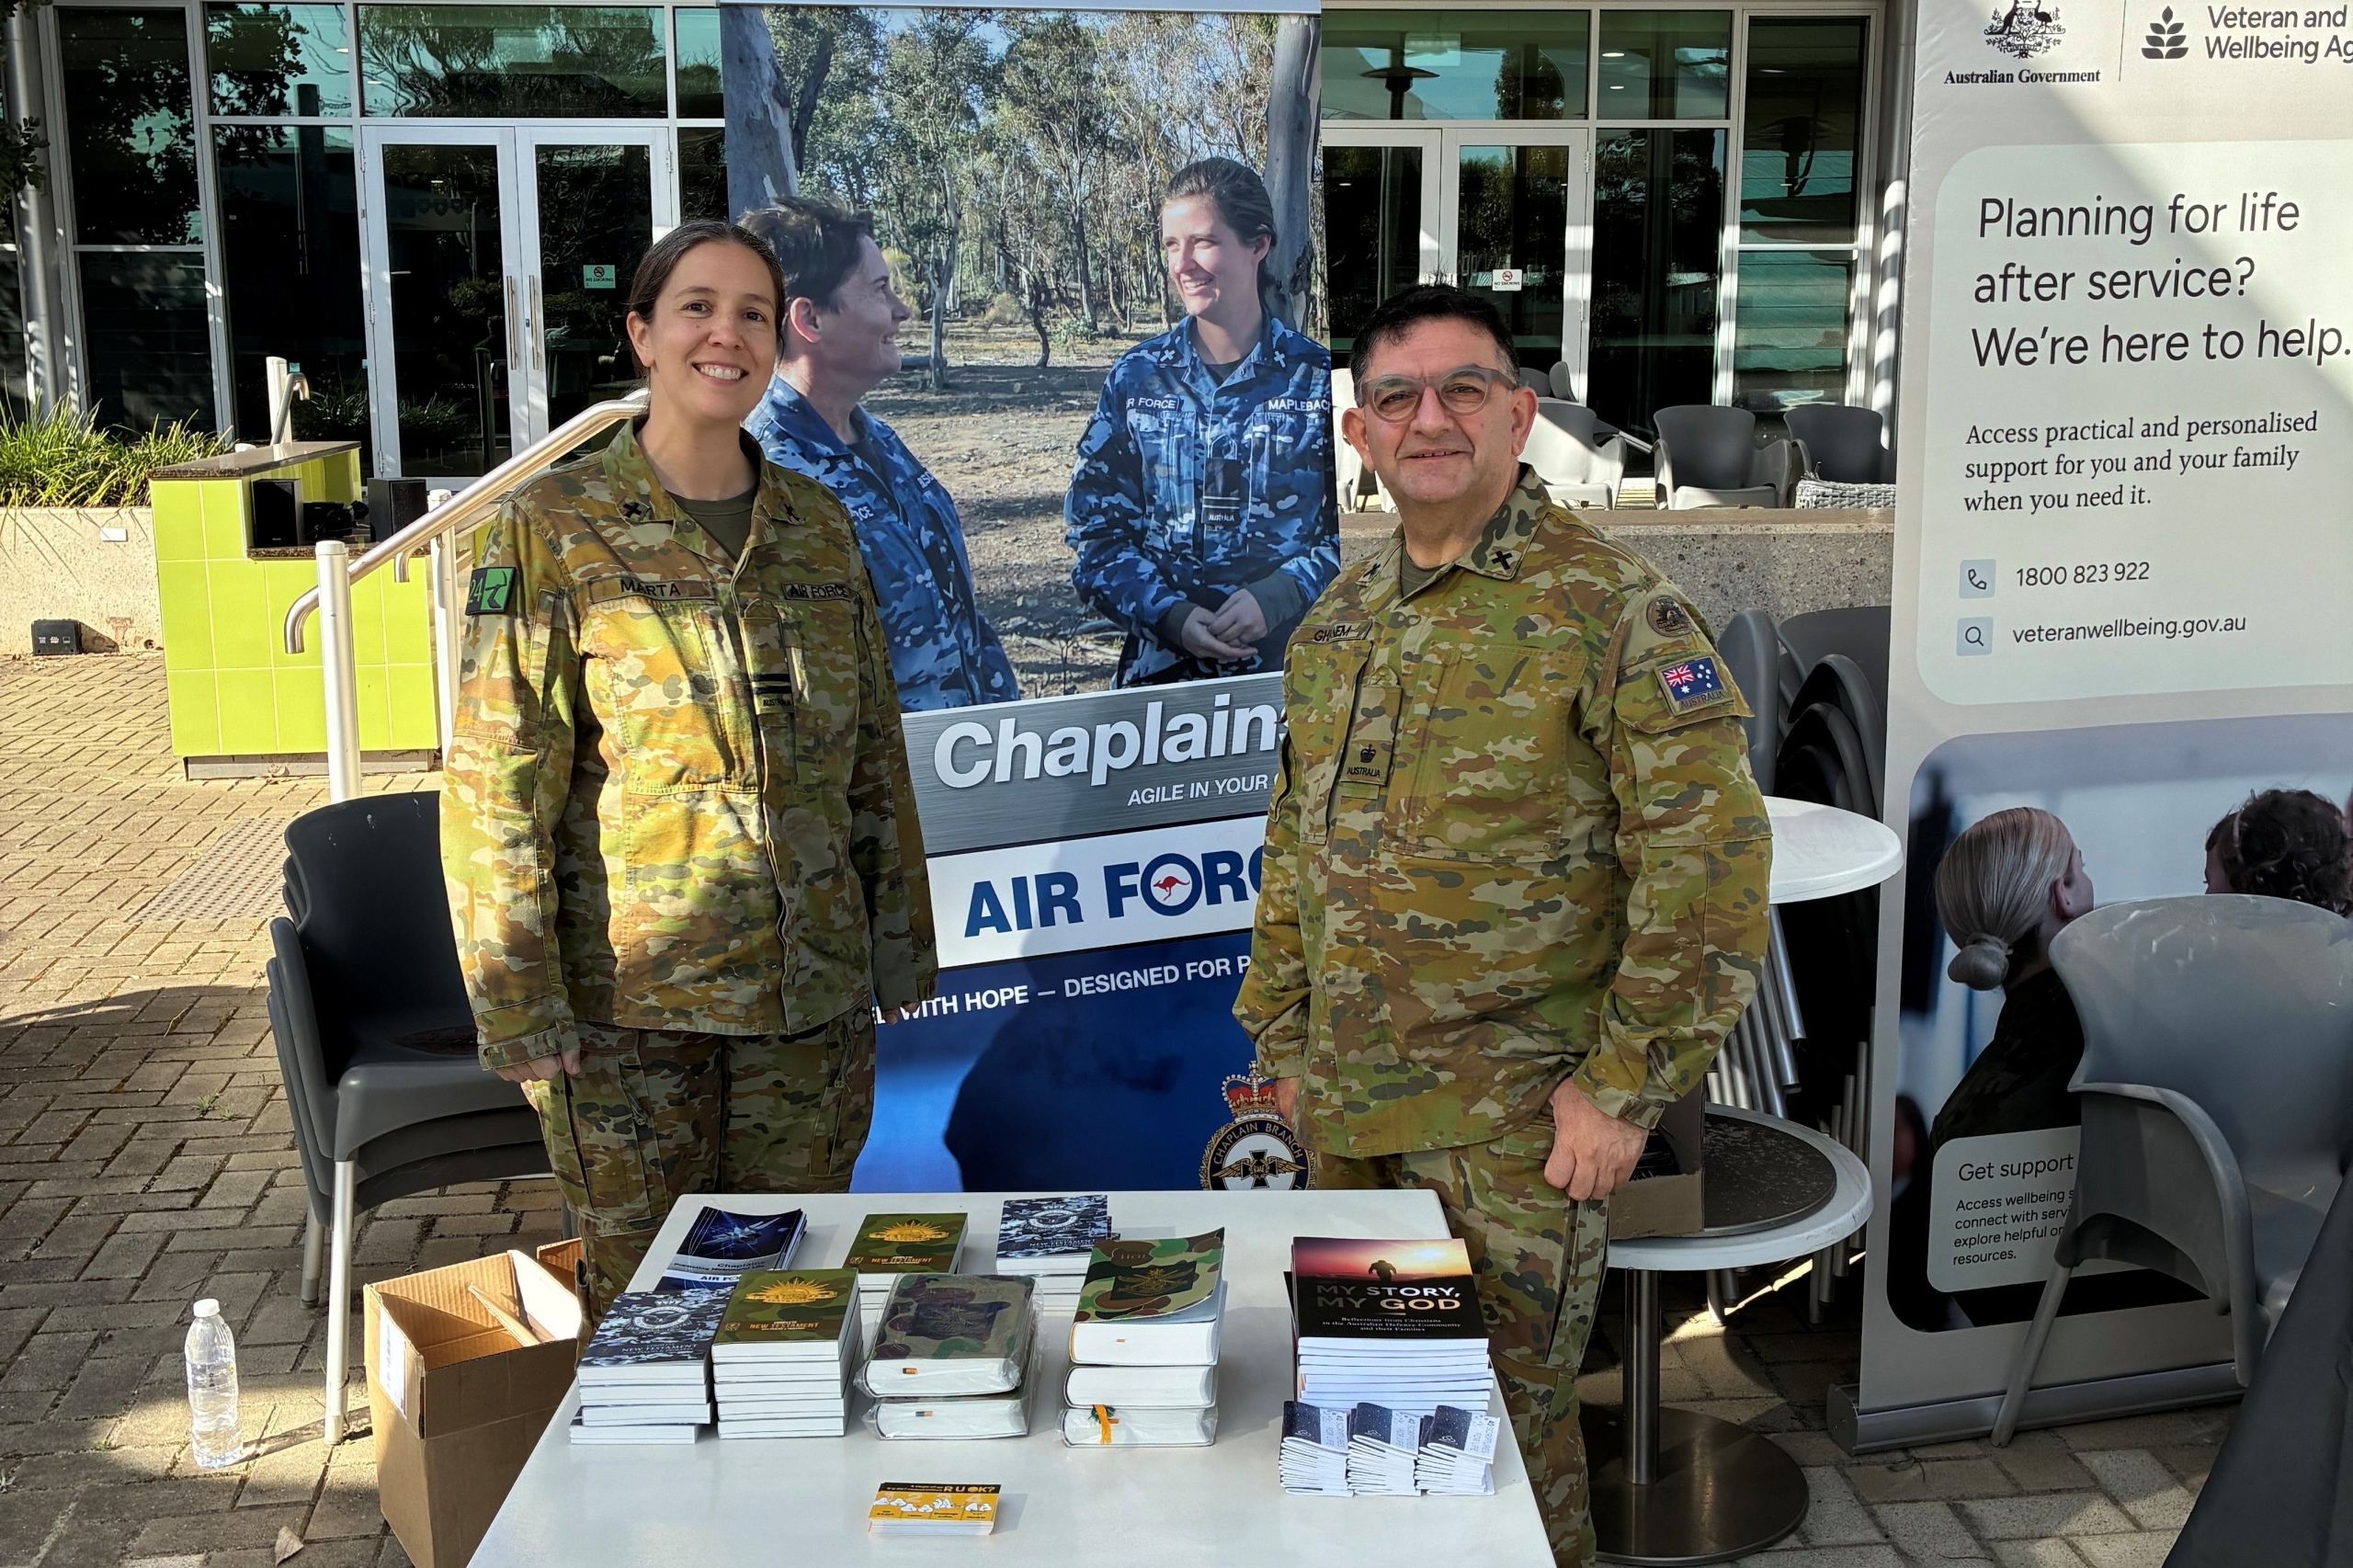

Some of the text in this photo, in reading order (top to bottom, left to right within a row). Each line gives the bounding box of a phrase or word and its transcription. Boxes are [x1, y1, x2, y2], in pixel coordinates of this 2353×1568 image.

[2207, 4, 2348, 28] Veteran and
[2204, 34, 2320, 64] Wellbeing
[1943, 69, 2101, 85] Australian Government
[1979, 191, 2300, 246] Planning for life
[1973, 256, 2255, 304] after service?
[2101, 324, 2189, 364] here
[2202, 323, 2244, 360] to
[2257, 318, 2352, 367] help.
[1138, 396, 1176, 409] FORCE
[1267, 398, 1330, 414] MAPLEBAC
[1965, 411, 2319, 448] Access practical and personalised
[1964, 445, 2300, 483] support for you and your family
[1963, 485, 2153, 515] when you need it.
[1208, 513, 1235, 522] AUSTRALIA
[2016, 561, 2151, 587] 1800 823 922
[620, 578, 681, 597] MARTA
[790, 584, 810, 598] AIR
[2012, 615, 2246, 644] veteranwellbeing.gov.au
[1679, 690, 1725, 709] AUSTRALIA
[1347, 767, 1381, 778] AUSTRALIA
[1127, 784, 1184, 807] AGILE
[1189, 781, 1210, 799] IN
[1214, 774, 1268, 795] YOUR
[963, 870, 1085, 938] AIR
[964, 984, 1029, 1012] HOPE
[1063, 964, 1180, 999] DESIGNED
[1186, 958, 1232, 982] FOR
[1213, 1122, 1303, 1165] CHAPLAIN BRANCH
[1958, 1153, 2075, 1182] Get support
[1955, 1198, 2002, 1212] Access
[2006, 1189, 2065, 1208] wellbeing
[1954, 1213, 2007, 1230] connect
[2010, 1210, 2039, 1224] with
[1953, 1232, 2001, 1249] explore
[2004, 1226, 2047, 1245] helpful
[1952, 1249, 2017, 1266] resources.
[1317, 1284, 1461, 1298] MY STORY,
[1317, 1296, 1461, 1310] MY GOD
